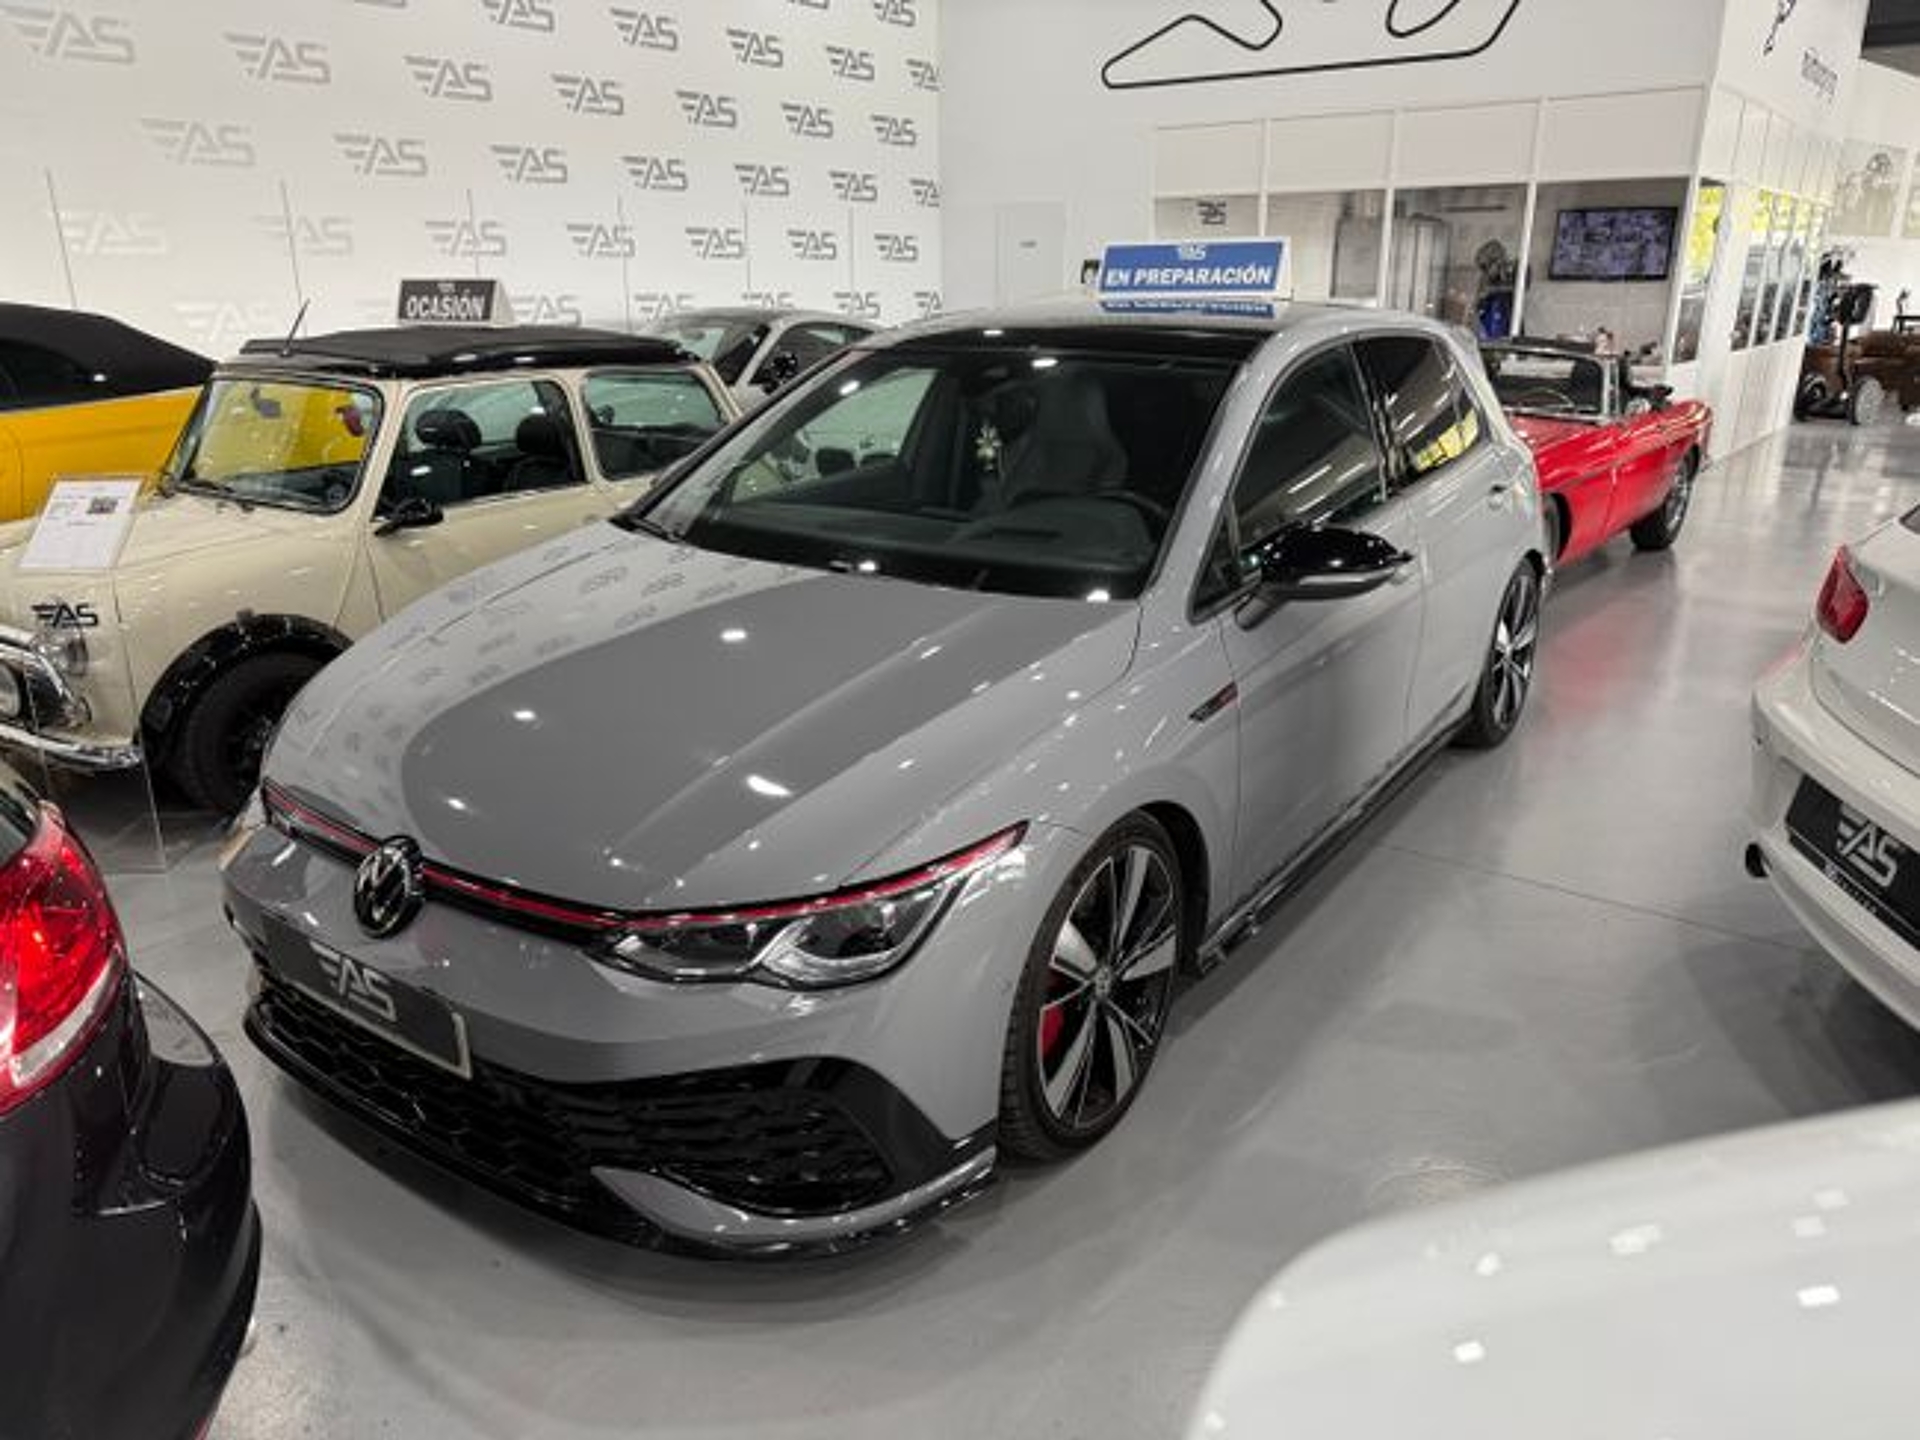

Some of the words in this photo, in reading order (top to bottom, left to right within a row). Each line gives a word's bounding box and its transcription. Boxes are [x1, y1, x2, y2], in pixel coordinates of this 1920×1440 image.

[1105, 268, 1130, 287] EN
[1134, 264, 1272, 286] PREPARACIÓN
[407, 288, 485, 318] OCASIÓN
